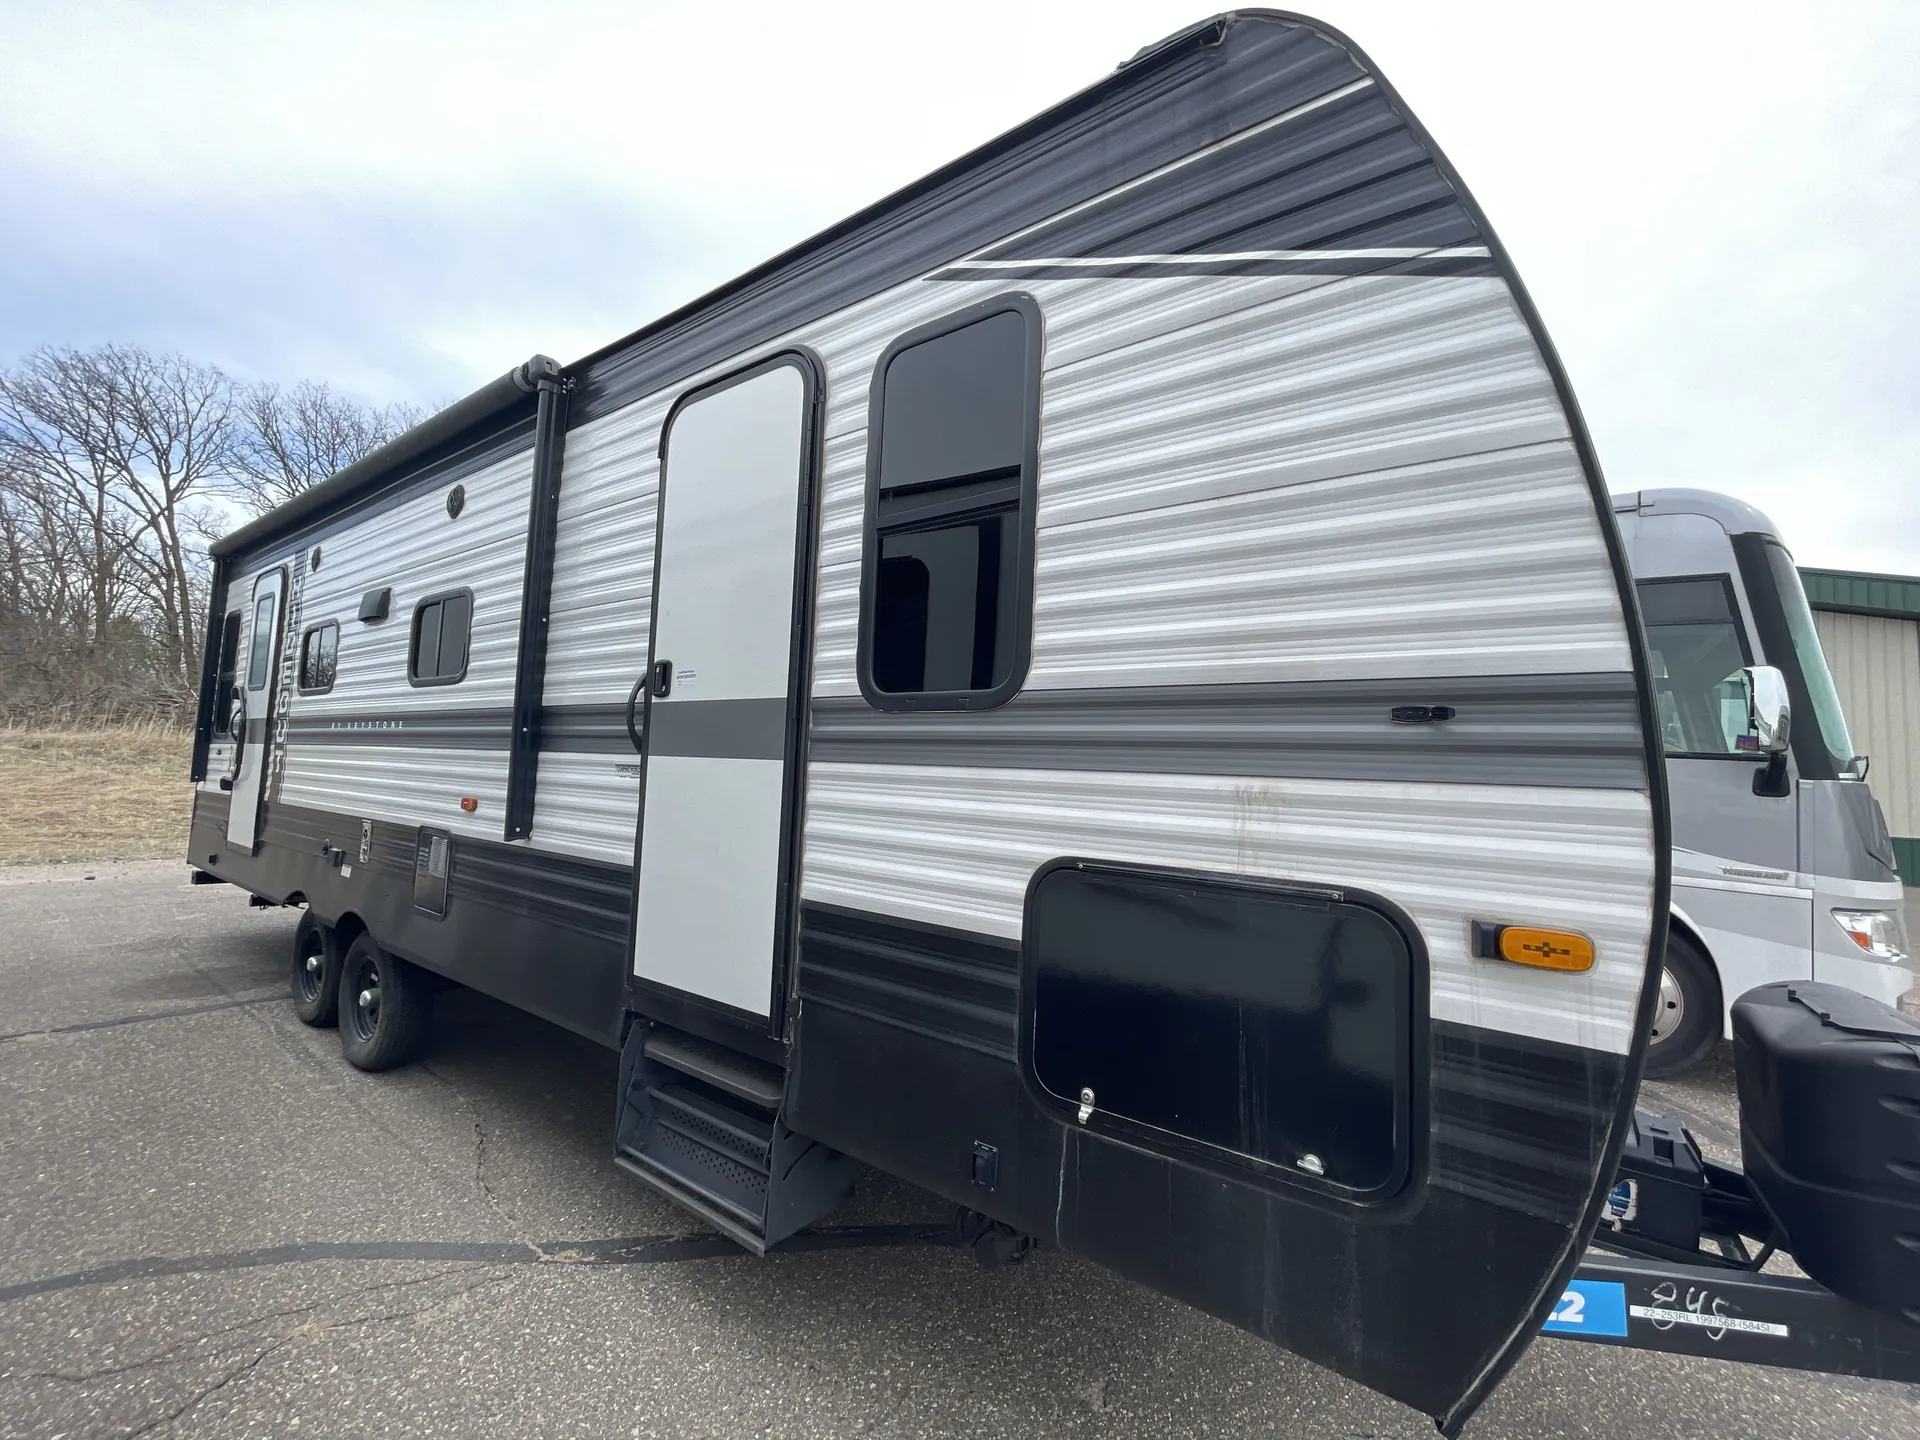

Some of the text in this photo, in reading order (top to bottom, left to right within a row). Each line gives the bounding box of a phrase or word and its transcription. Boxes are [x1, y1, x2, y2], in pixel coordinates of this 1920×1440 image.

[275, 576, 302, 773] HIDEOUT
[347, 720, 403, 730] KEYSTONE
[1643, 1307, 1692, 1322] 22-253RL
[1695, 1314, 1736, 1328] 1997568
